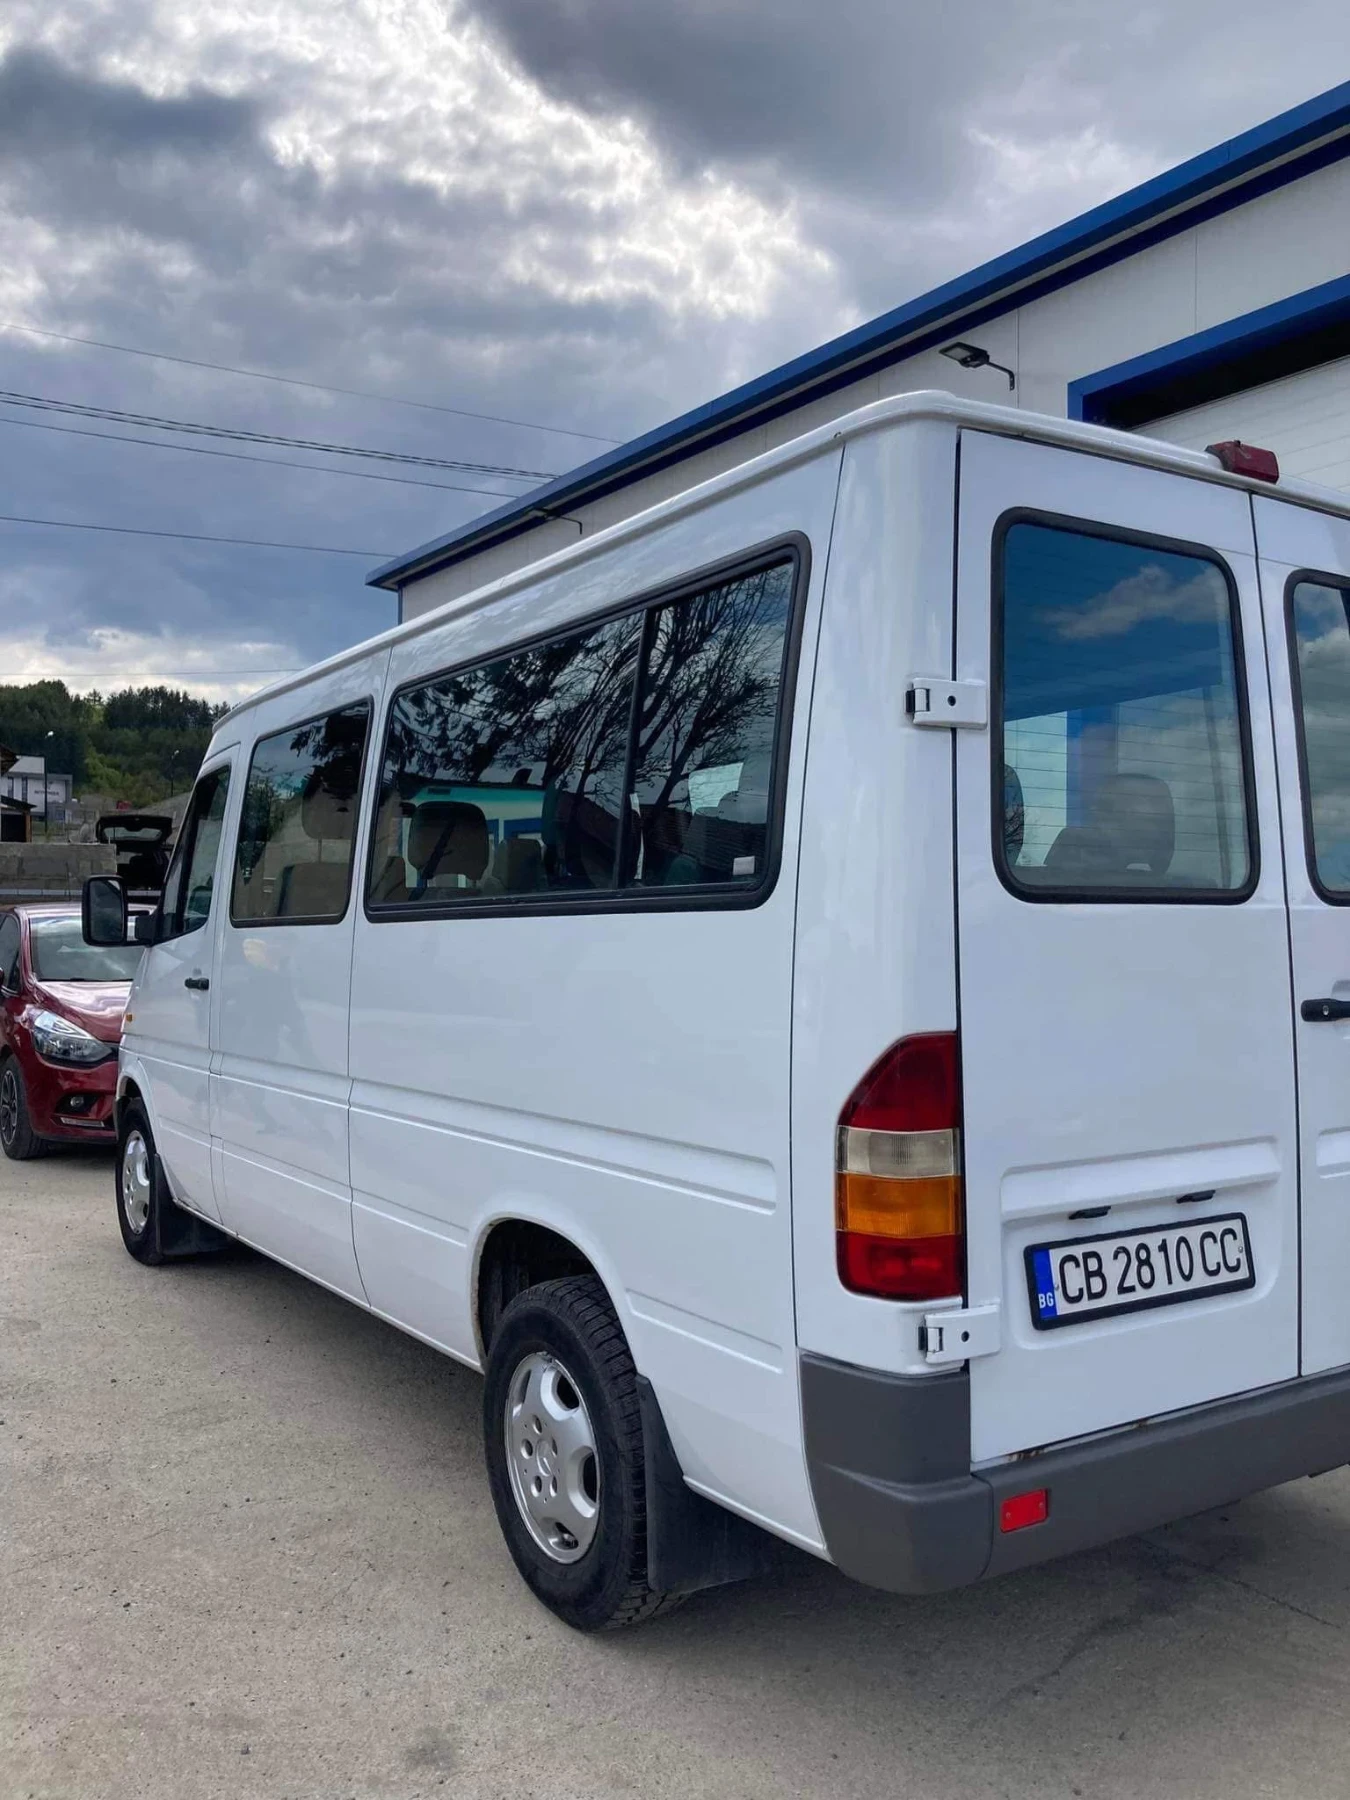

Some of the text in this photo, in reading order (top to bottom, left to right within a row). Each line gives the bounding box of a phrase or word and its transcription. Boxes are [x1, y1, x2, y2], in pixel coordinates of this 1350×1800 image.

[1059, 1227, 1241, 1304] CB 2810 CC
[1038, 1292, 1054, 1309] BG
